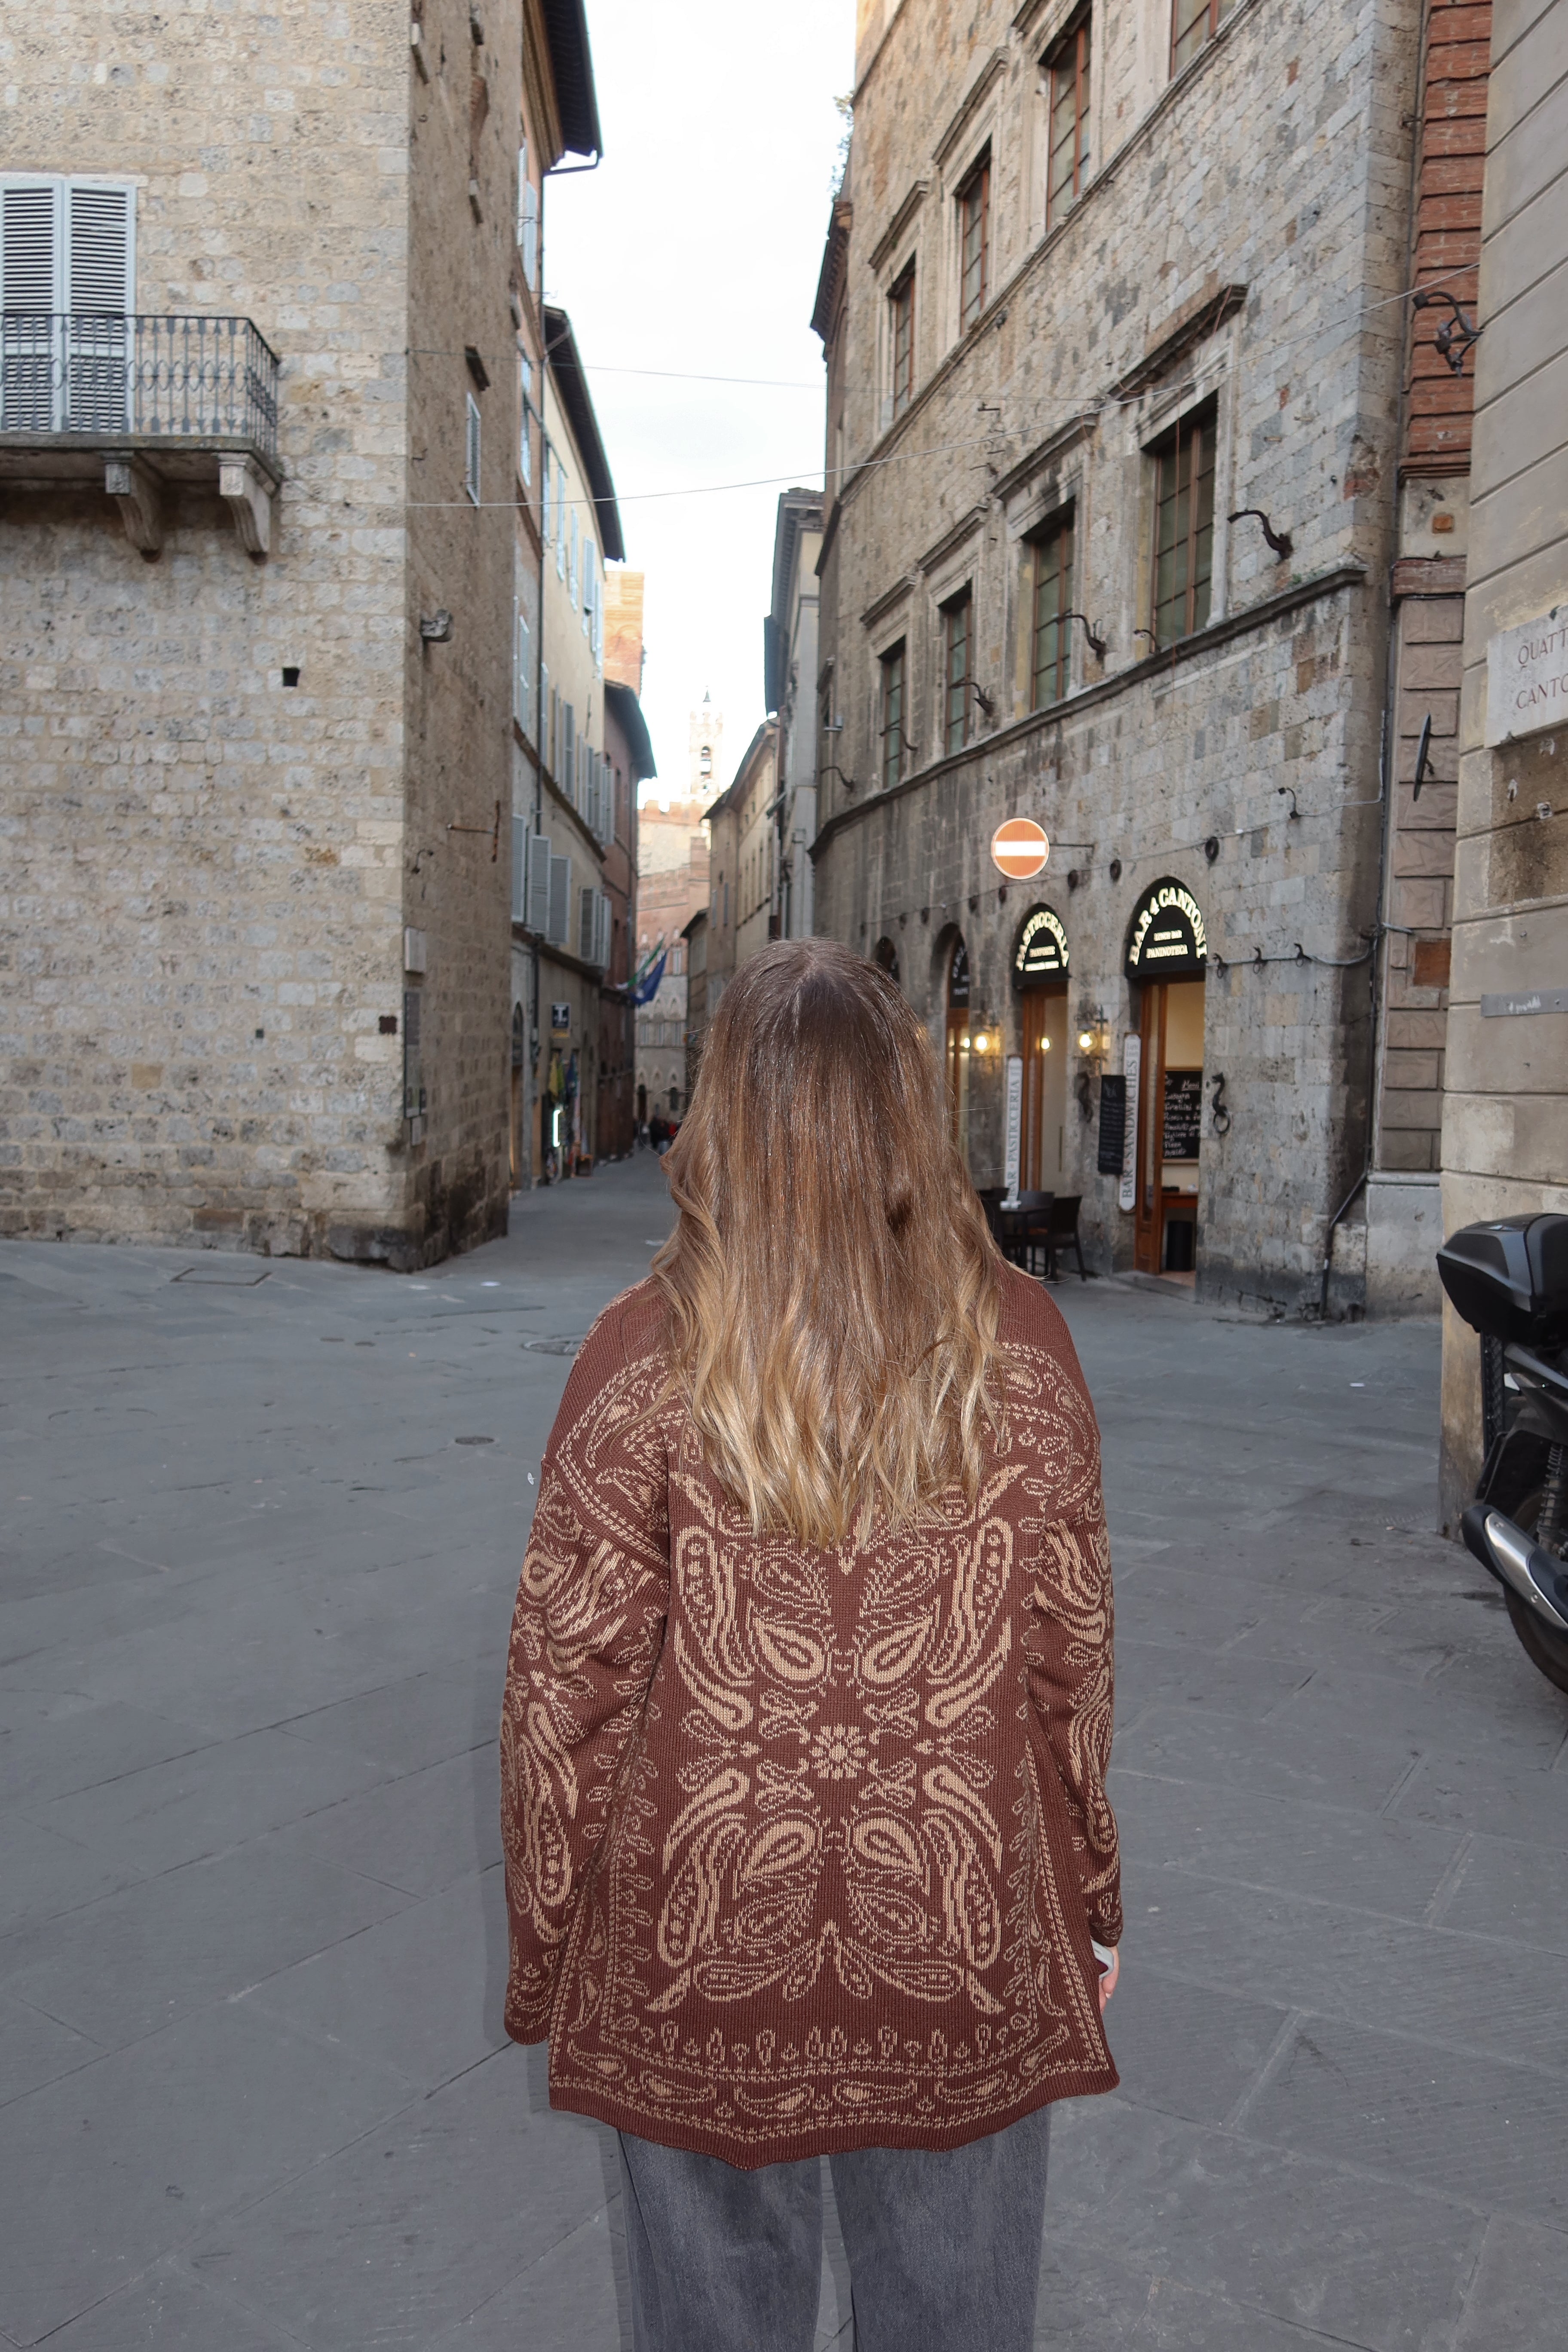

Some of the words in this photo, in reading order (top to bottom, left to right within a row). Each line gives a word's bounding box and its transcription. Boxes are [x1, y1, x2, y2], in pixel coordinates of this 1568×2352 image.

[1519, 627, 1568, 672] QUATT
[1015, 911, 1069, 971] PASTICCERIA
[1129, 910, 1152, 965] BAR
[1150, 897, 1160, 915] 4
[1158, 887, 1207, 959] CANTONI
[1146, 944, 1188, 959] PANINOTECA
[1171, 930, 1182, 939] BAR
[1009, 1080, 1020, 1162] PASTICCERIA
[1124, 1060, 1138, 1159] SANDWICHES
[1123, 1167, 1134, 1198] BAR
